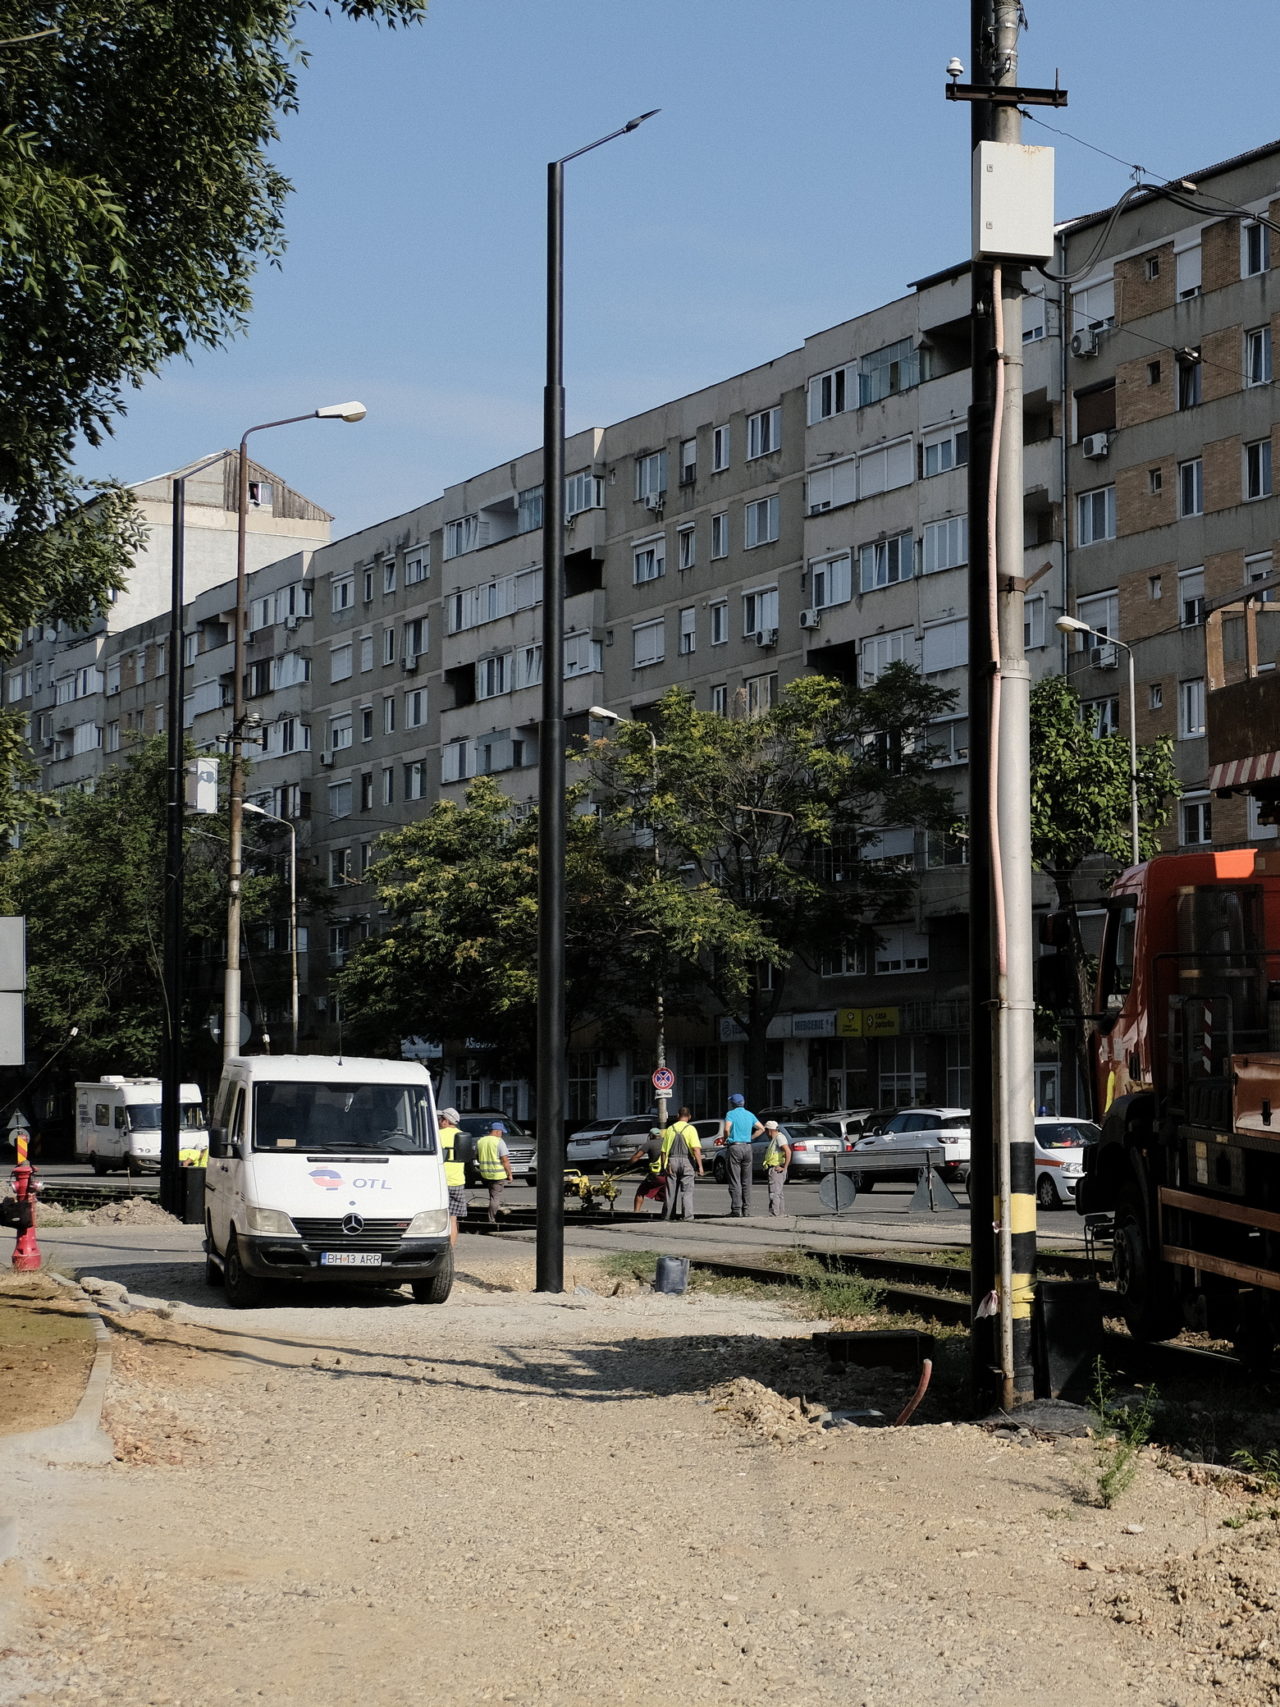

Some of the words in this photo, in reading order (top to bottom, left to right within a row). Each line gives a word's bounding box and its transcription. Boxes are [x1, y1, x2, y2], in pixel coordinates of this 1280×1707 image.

[353, 1178, 392, 1190] OTL
[327, 1254, 343, 1264] BH
[346, 1254, 356, 1264] 13
[360, 1254, 381, 1265] ARR
